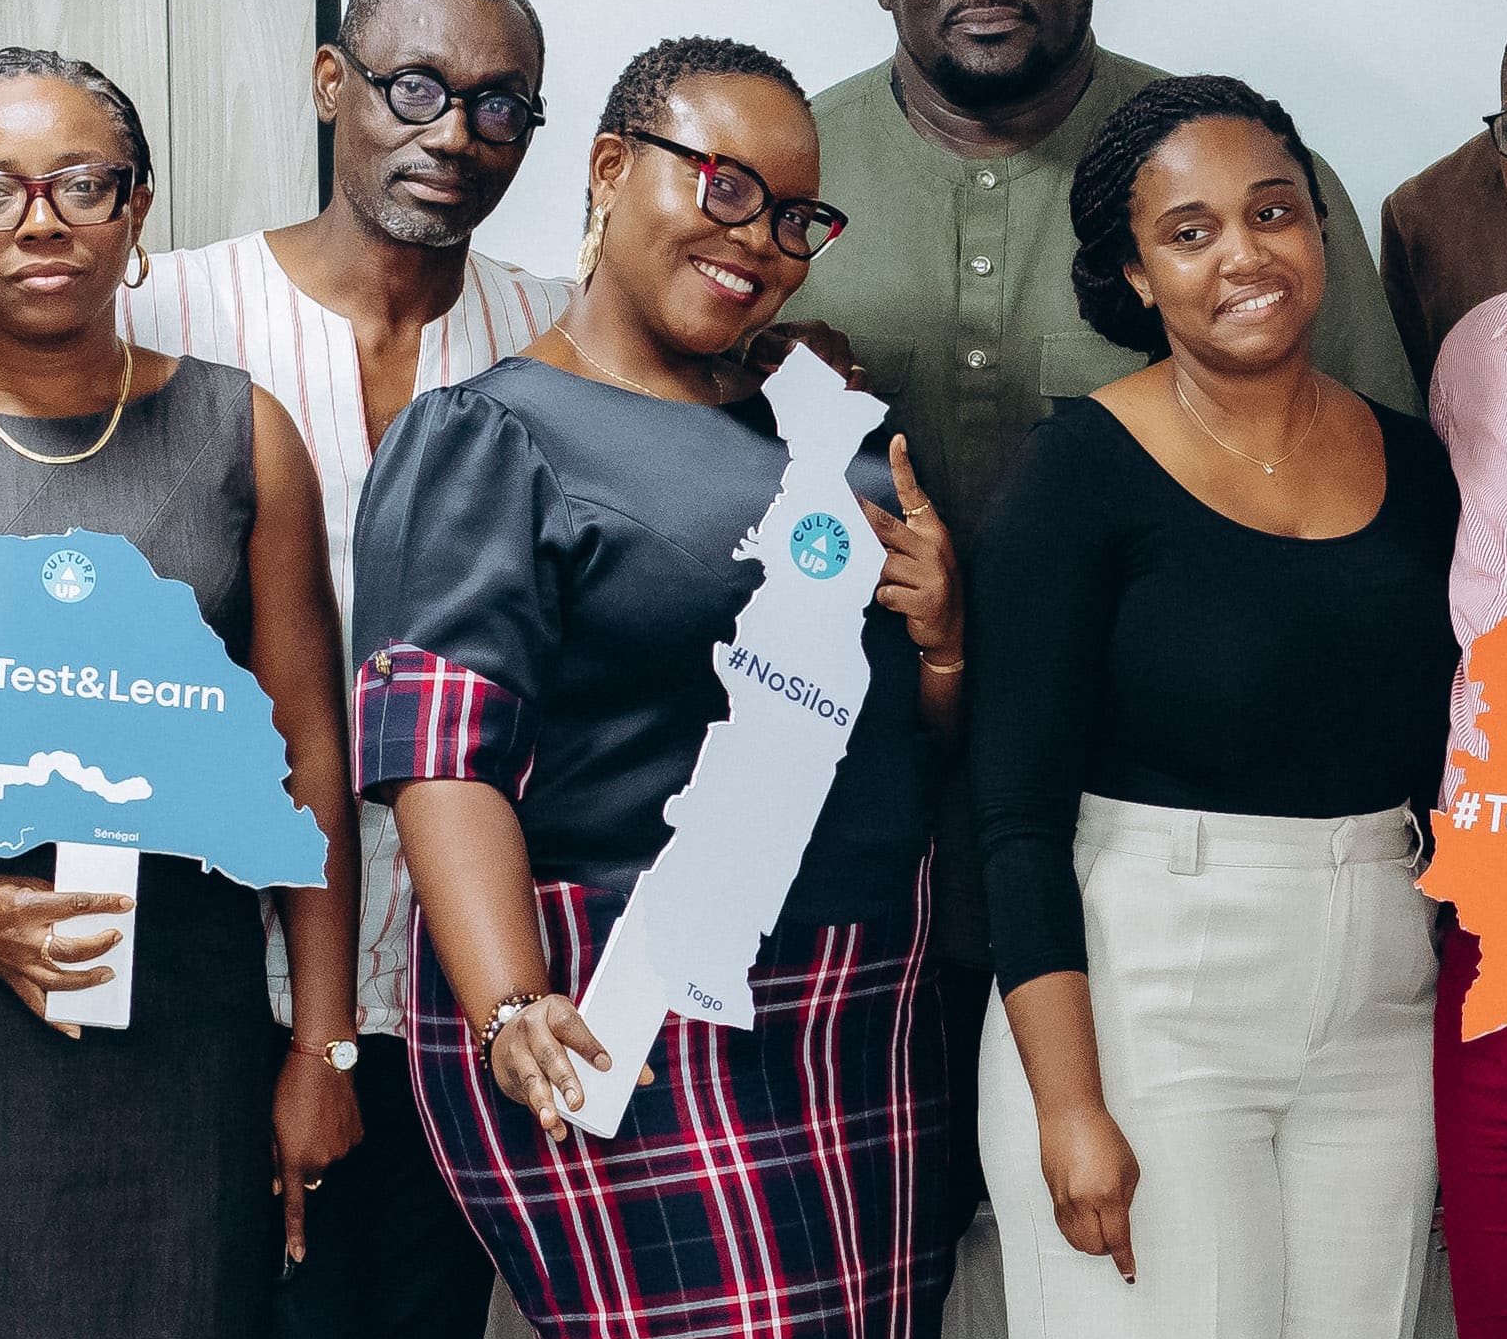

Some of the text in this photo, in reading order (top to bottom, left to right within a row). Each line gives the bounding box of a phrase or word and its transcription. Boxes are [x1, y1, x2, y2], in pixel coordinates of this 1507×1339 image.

[792, 515, 848, 565] CULTURE
[43, 552, 94, 585] CULTURE
[799, 551, 828, 575] UP
[54, 584, 81, 599] UP
[728, 647, 850, 728] #NoSilos
[93, 828, 140, 843] Sénégal
[686, 982, 724, 1012] Togo
